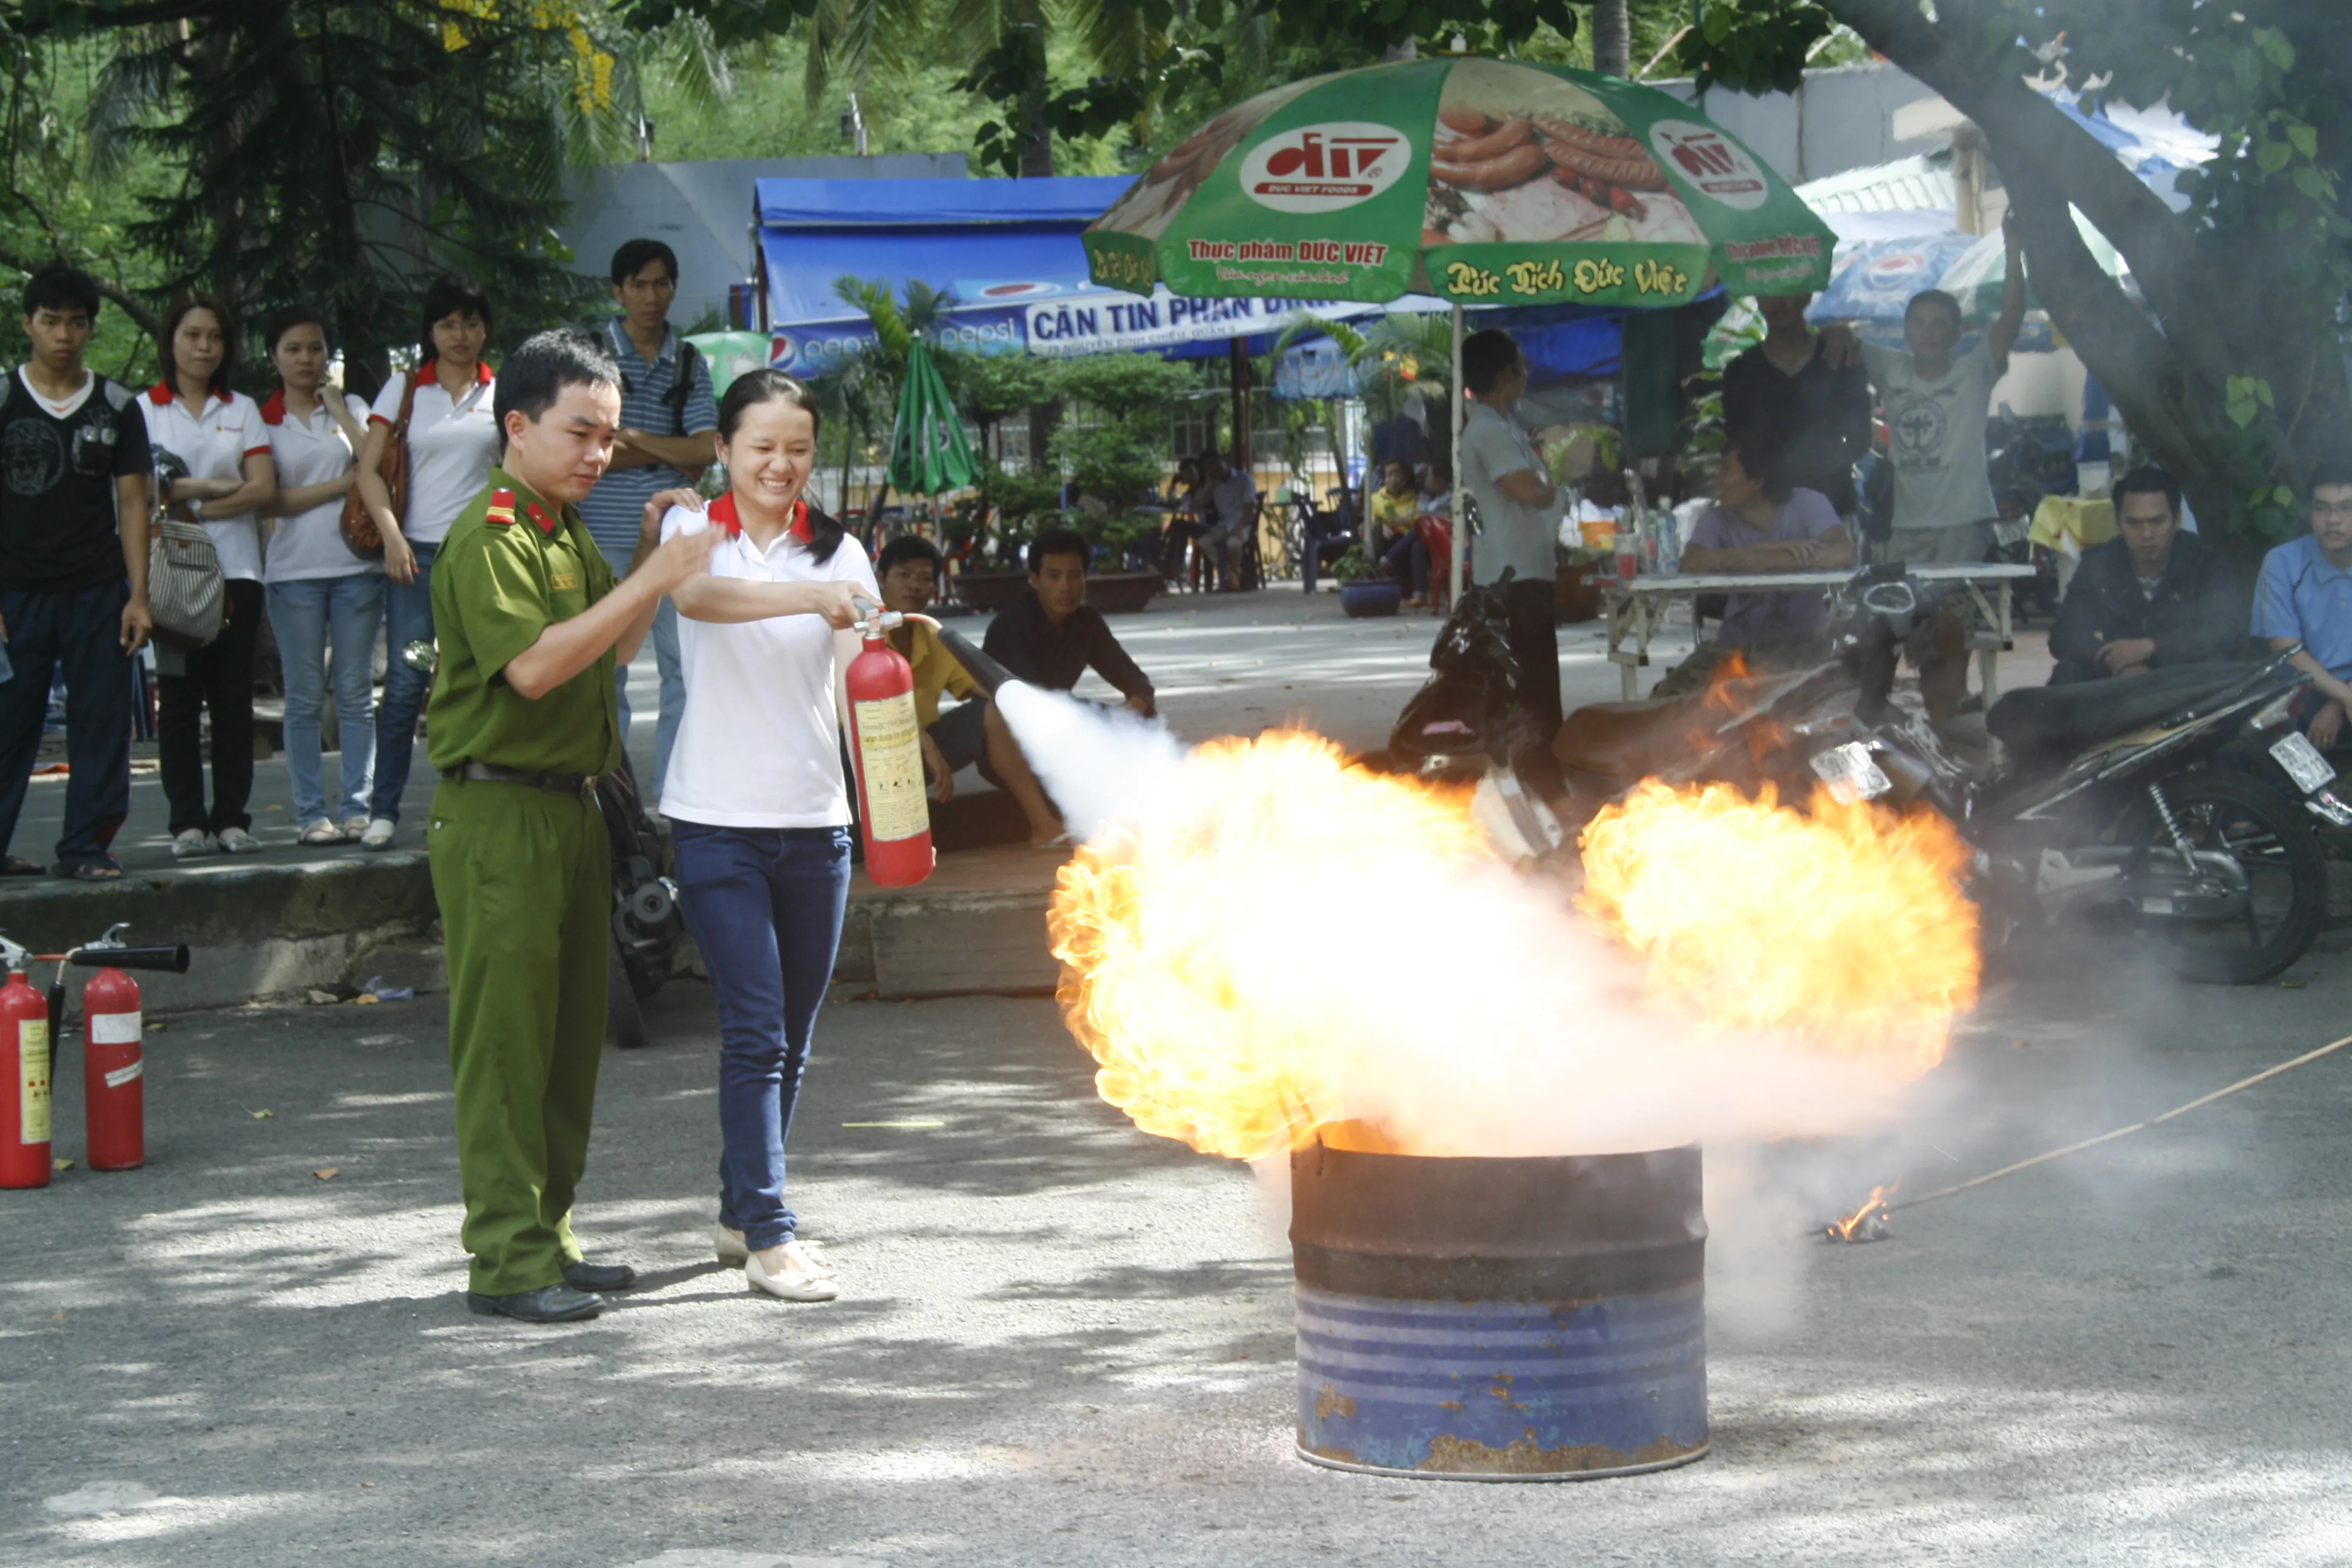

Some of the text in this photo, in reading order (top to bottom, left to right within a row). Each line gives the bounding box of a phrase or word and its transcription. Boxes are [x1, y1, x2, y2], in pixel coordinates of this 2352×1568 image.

[1321, 186, 1359, 194] FOODS
[1635, 258, 1687, 296] Việt
[941, 318, 1015, 349] pepsi
[1034, 304, 1097, 340] CĂN
[1107, 301, 1160, 333] TIN
